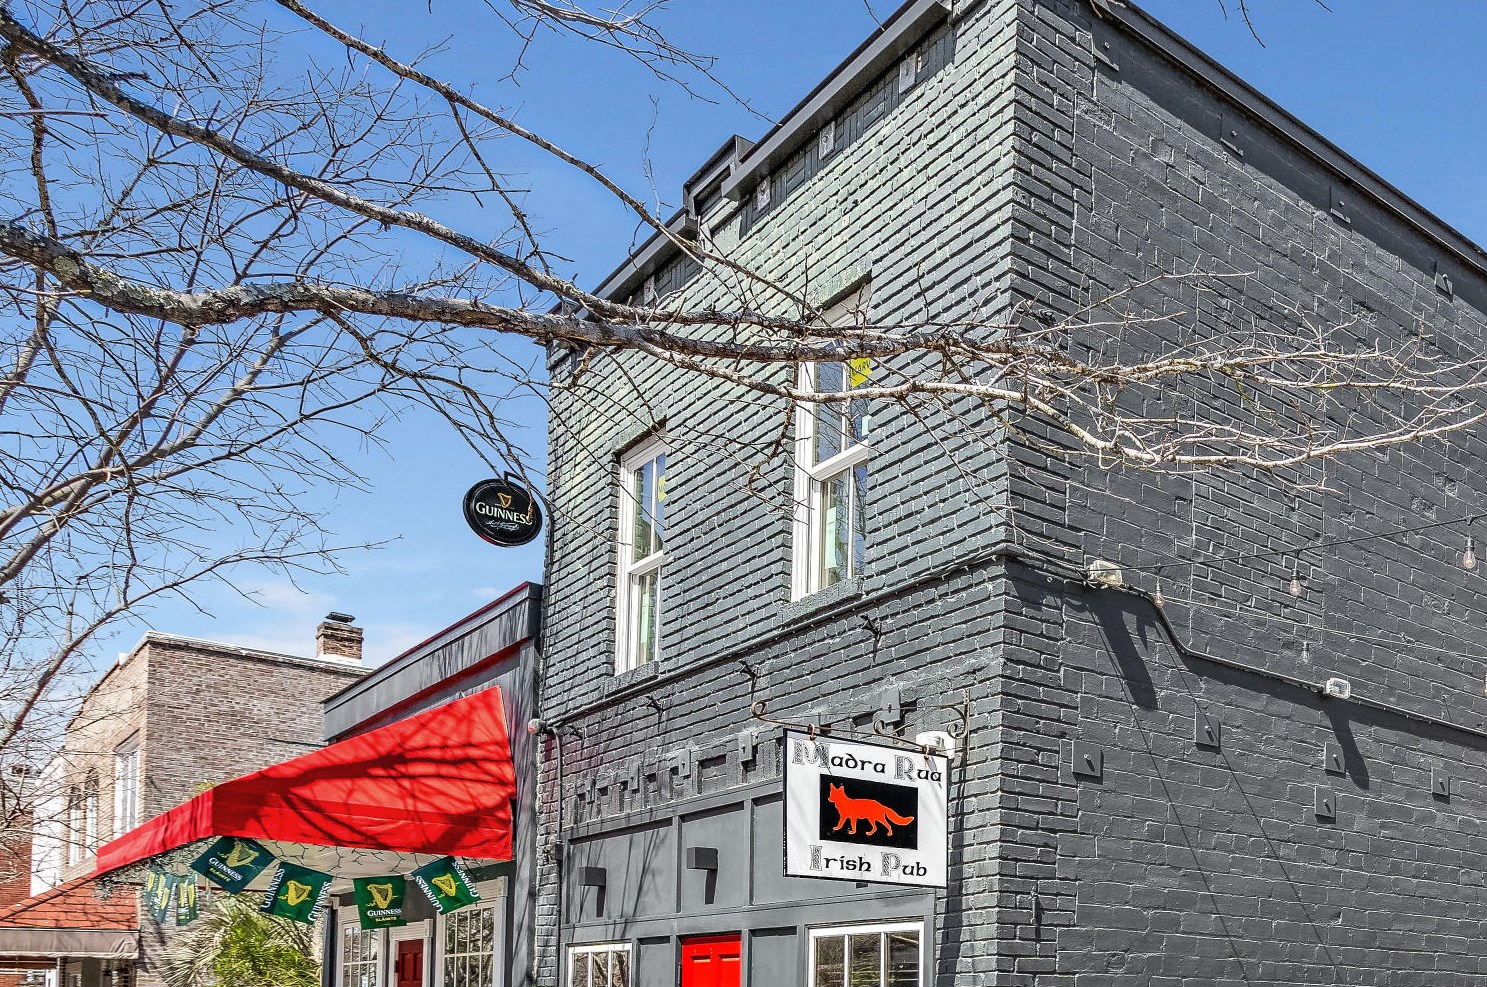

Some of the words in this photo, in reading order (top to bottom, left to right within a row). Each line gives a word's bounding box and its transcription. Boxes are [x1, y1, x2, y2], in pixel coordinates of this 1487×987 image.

[792, 740, 886, 774] Madra
[893, 754, 942, 782] Rua
[208, 857, 243, 881] GUINNESS
[809, 845, 871, 871] Irish
[880, 852, 927, 877] Pub
[367, 908, 402, 917] GUINNESS
